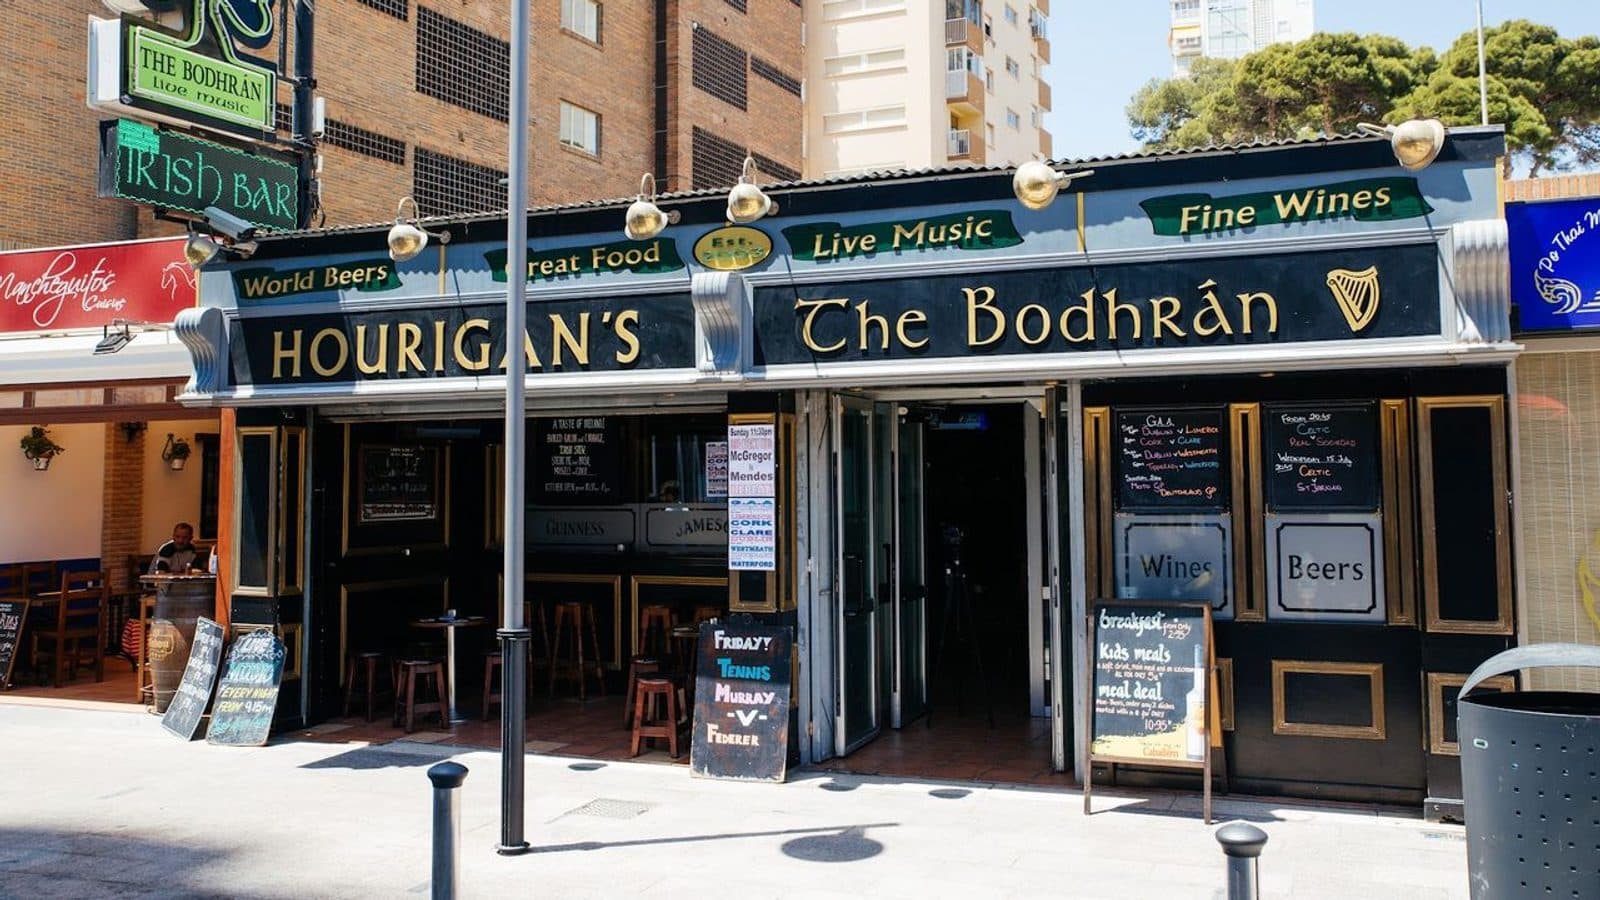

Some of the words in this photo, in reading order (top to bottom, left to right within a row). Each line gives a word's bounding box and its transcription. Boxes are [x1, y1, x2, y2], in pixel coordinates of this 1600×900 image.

[140, 47, 176, 77] THE
[182, 59, 262, 101] BODHRÁN
[233, 173, 293, 220] BAR
[1179, 203, 1256, 234] Fine
[1273, 186, 1391, 220] Wines
[813, 232, 875, 258] Live
[892, 216, 992, 248] Music
[1552, 221, 1585, 250] Thai
[505, 254, 581, 277] reat
[591, 240, 660, 269] Food
[244, 270, 314, 297] World
[324, 265, 388, 287] Beers
[794, 296, 930, 352] The
[730, 428, 749, 438] Sunday
[731, 450, 772, 463] McGregor
[1140, 554, 1212, 579] Wines
[1288, 555, 1364, 581] Beers
[1099, 608, 1165, 637] breakfast
[1099, 642, 1129, 660] Kids
[1134, 643, 1171, 663] meals
[717, 658, 771, 681] TENNIS
[714, 682, 775, 705] MURRAY
[1098, 680, 1131, 698] meal
[1134, 680, 1163, 700] deal
[706, 723, 760, 746] FEDERER
